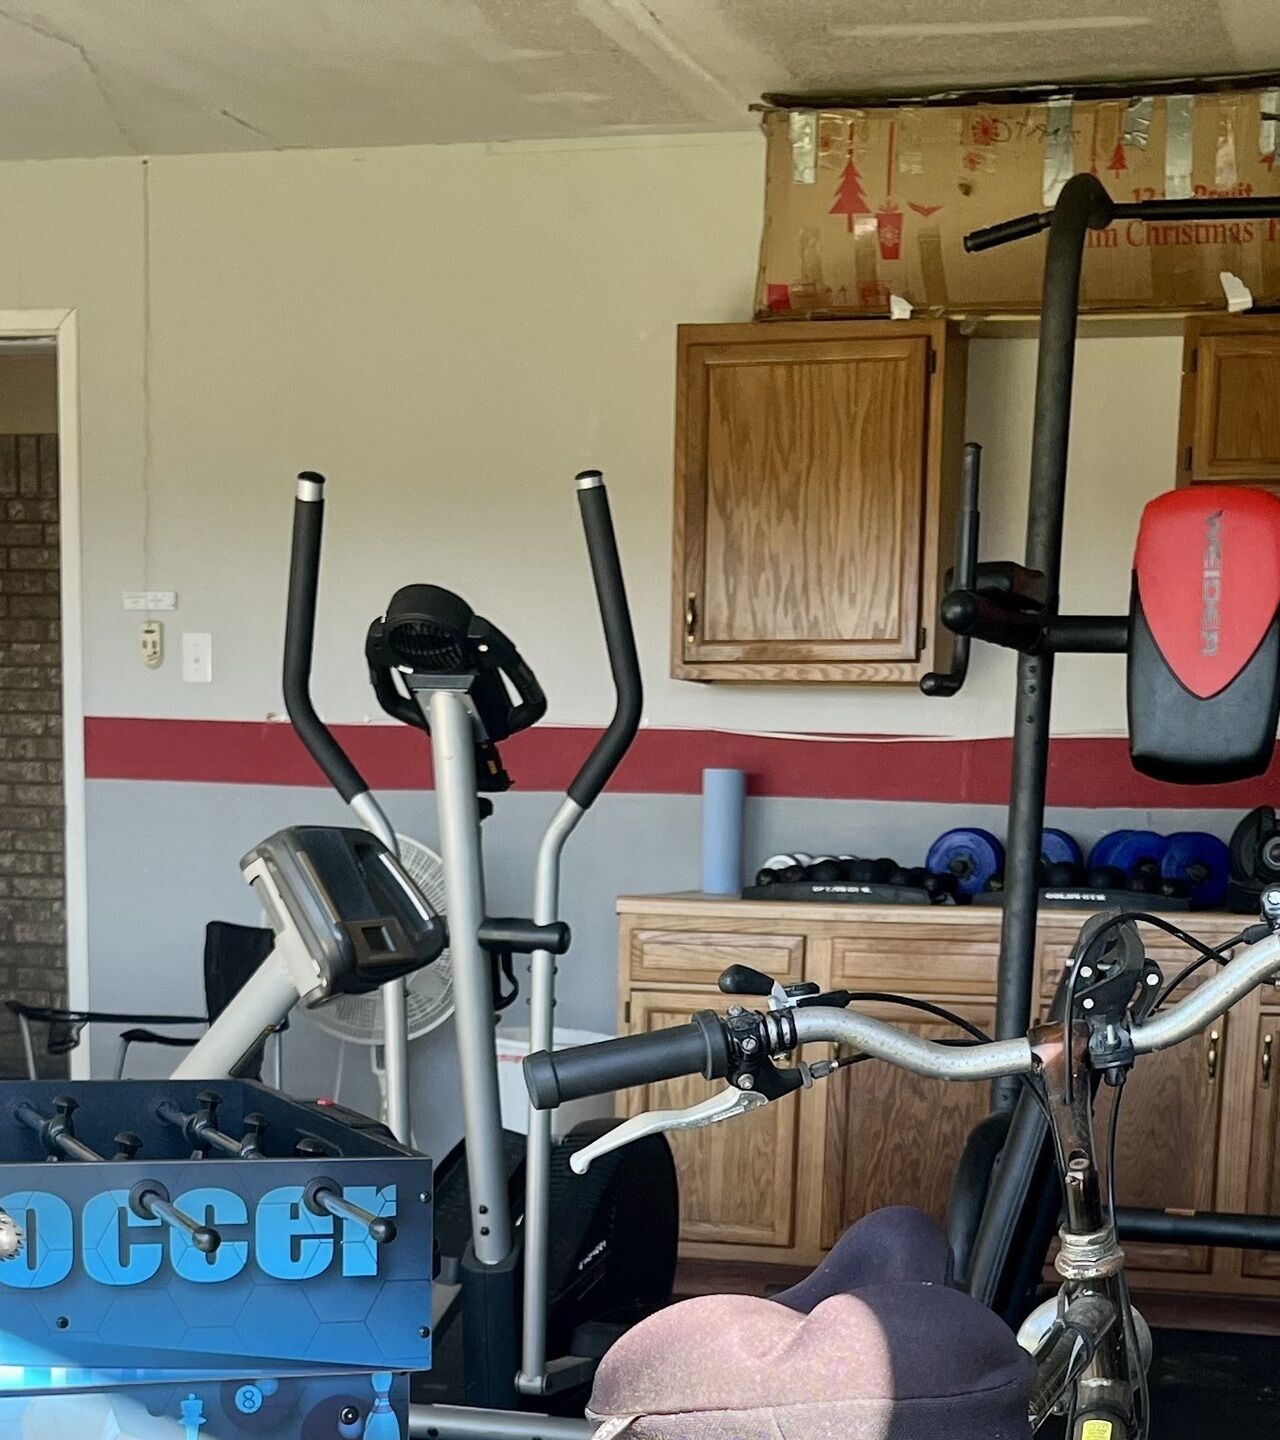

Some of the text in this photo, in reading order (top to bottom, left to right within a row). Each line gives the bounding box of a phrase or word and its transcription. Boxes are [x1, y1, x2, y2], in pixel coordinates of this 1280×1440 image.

[1125, 221, 1255, 247] Christmas
[1201, 509, 1225, 658] WEIDER
[242, 1389, 256, 1409] 8
